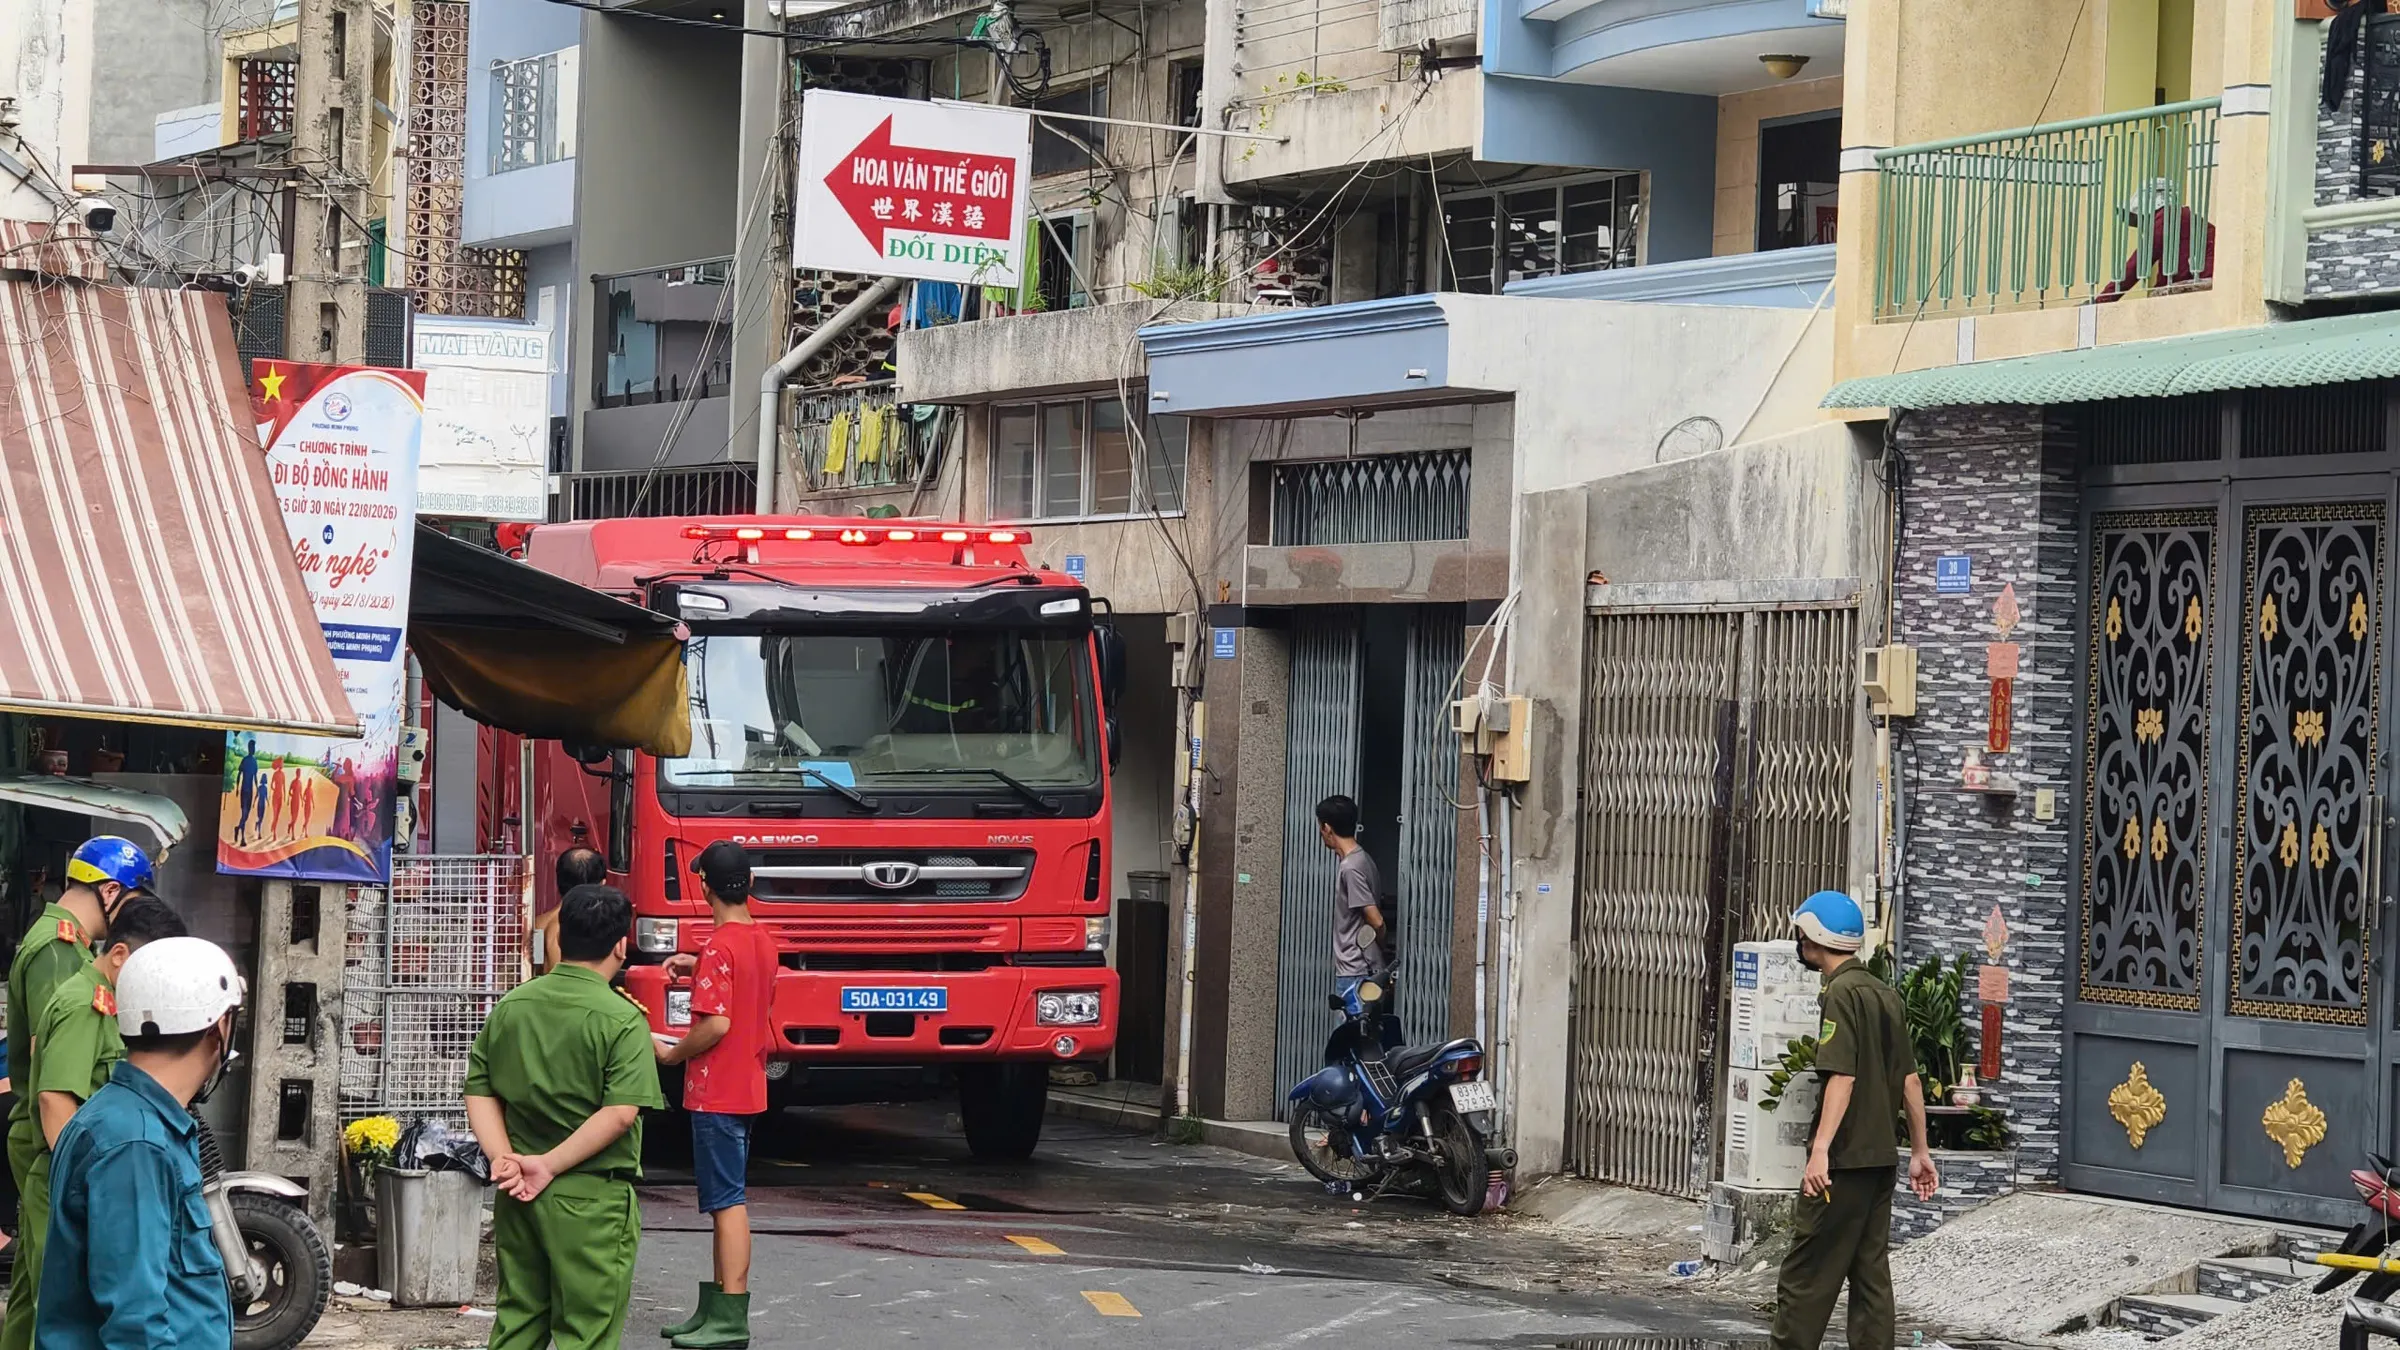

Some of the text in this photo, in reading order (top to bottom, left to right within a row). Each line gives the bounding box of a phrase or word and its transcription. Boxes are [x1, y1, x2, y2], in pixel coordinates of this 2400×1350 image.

[852, 156, 1007, 199] HOA VĂN THẾ GIỚI
[870, 196, 986, 230] 世界漢語
[888, 233, 935, 261] ĐỐI
[418, 331, 544, 359] MAI VÀNG
[300, 440, 368, 456] CHƯƠNG TRÌNH
[275, 458, 388, 492] ĐI BỘ ĐỒNG HÀNH
[283, 498, 290, 512] 5
[292, 495, 308, 513] GIỜ
[310, 499, 322, 514] 30
[324, 497, 347, 516] NGÀY
[323, 529, 333, 540] và
[294, 538, 379, 589] ăn nghệ
[732, 835, 819, 844] DAEWOO
[987, 835, 1034, 845] NOVUS
[850, 991, 938, 1007] 50A-031.49
